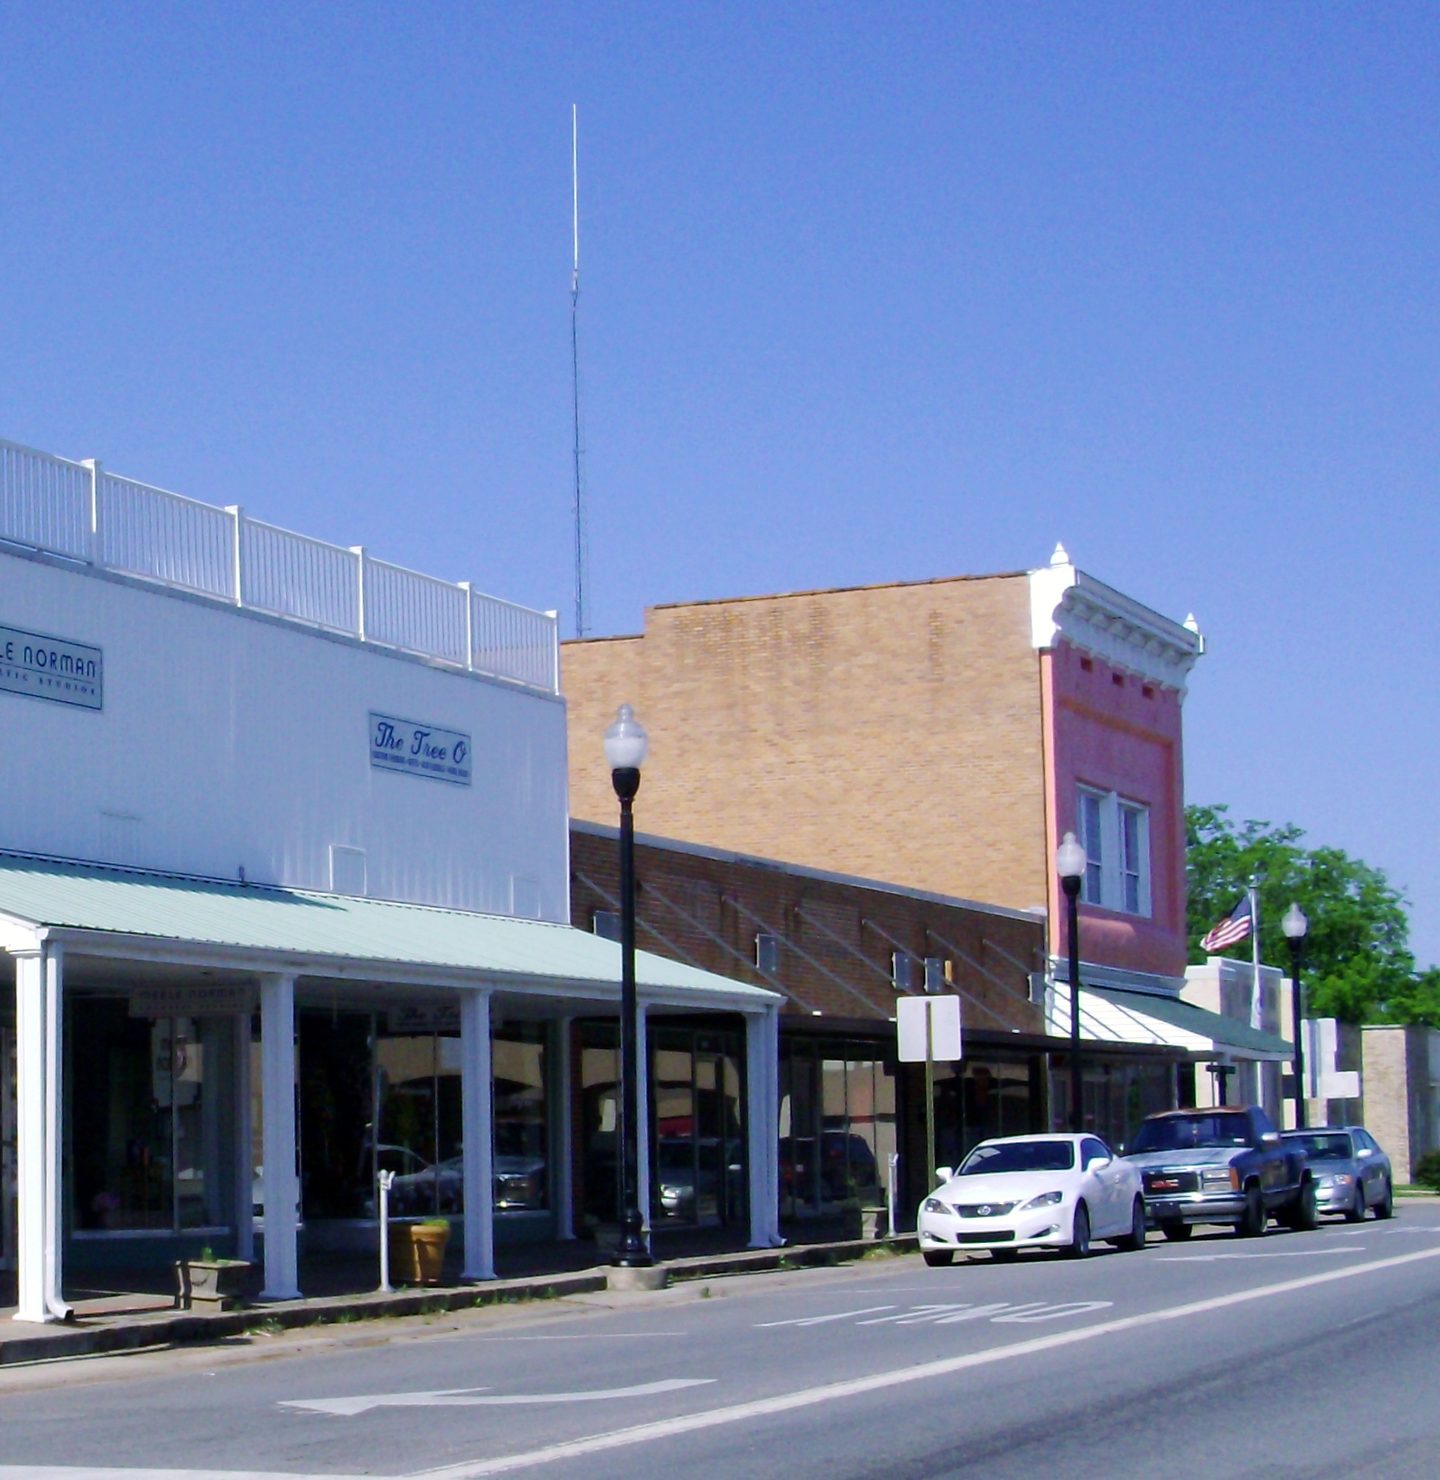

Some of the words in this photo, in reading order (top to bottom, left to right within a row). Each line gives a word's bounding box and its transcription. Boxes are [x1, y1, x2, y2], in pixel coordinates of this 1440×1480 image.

[23, 646, 96, 678] NORMAN
[375, 721, 404, 751] The
[410, 730, 447, 760] Tree
[752, 1301, 1114, 1328] ONLY
